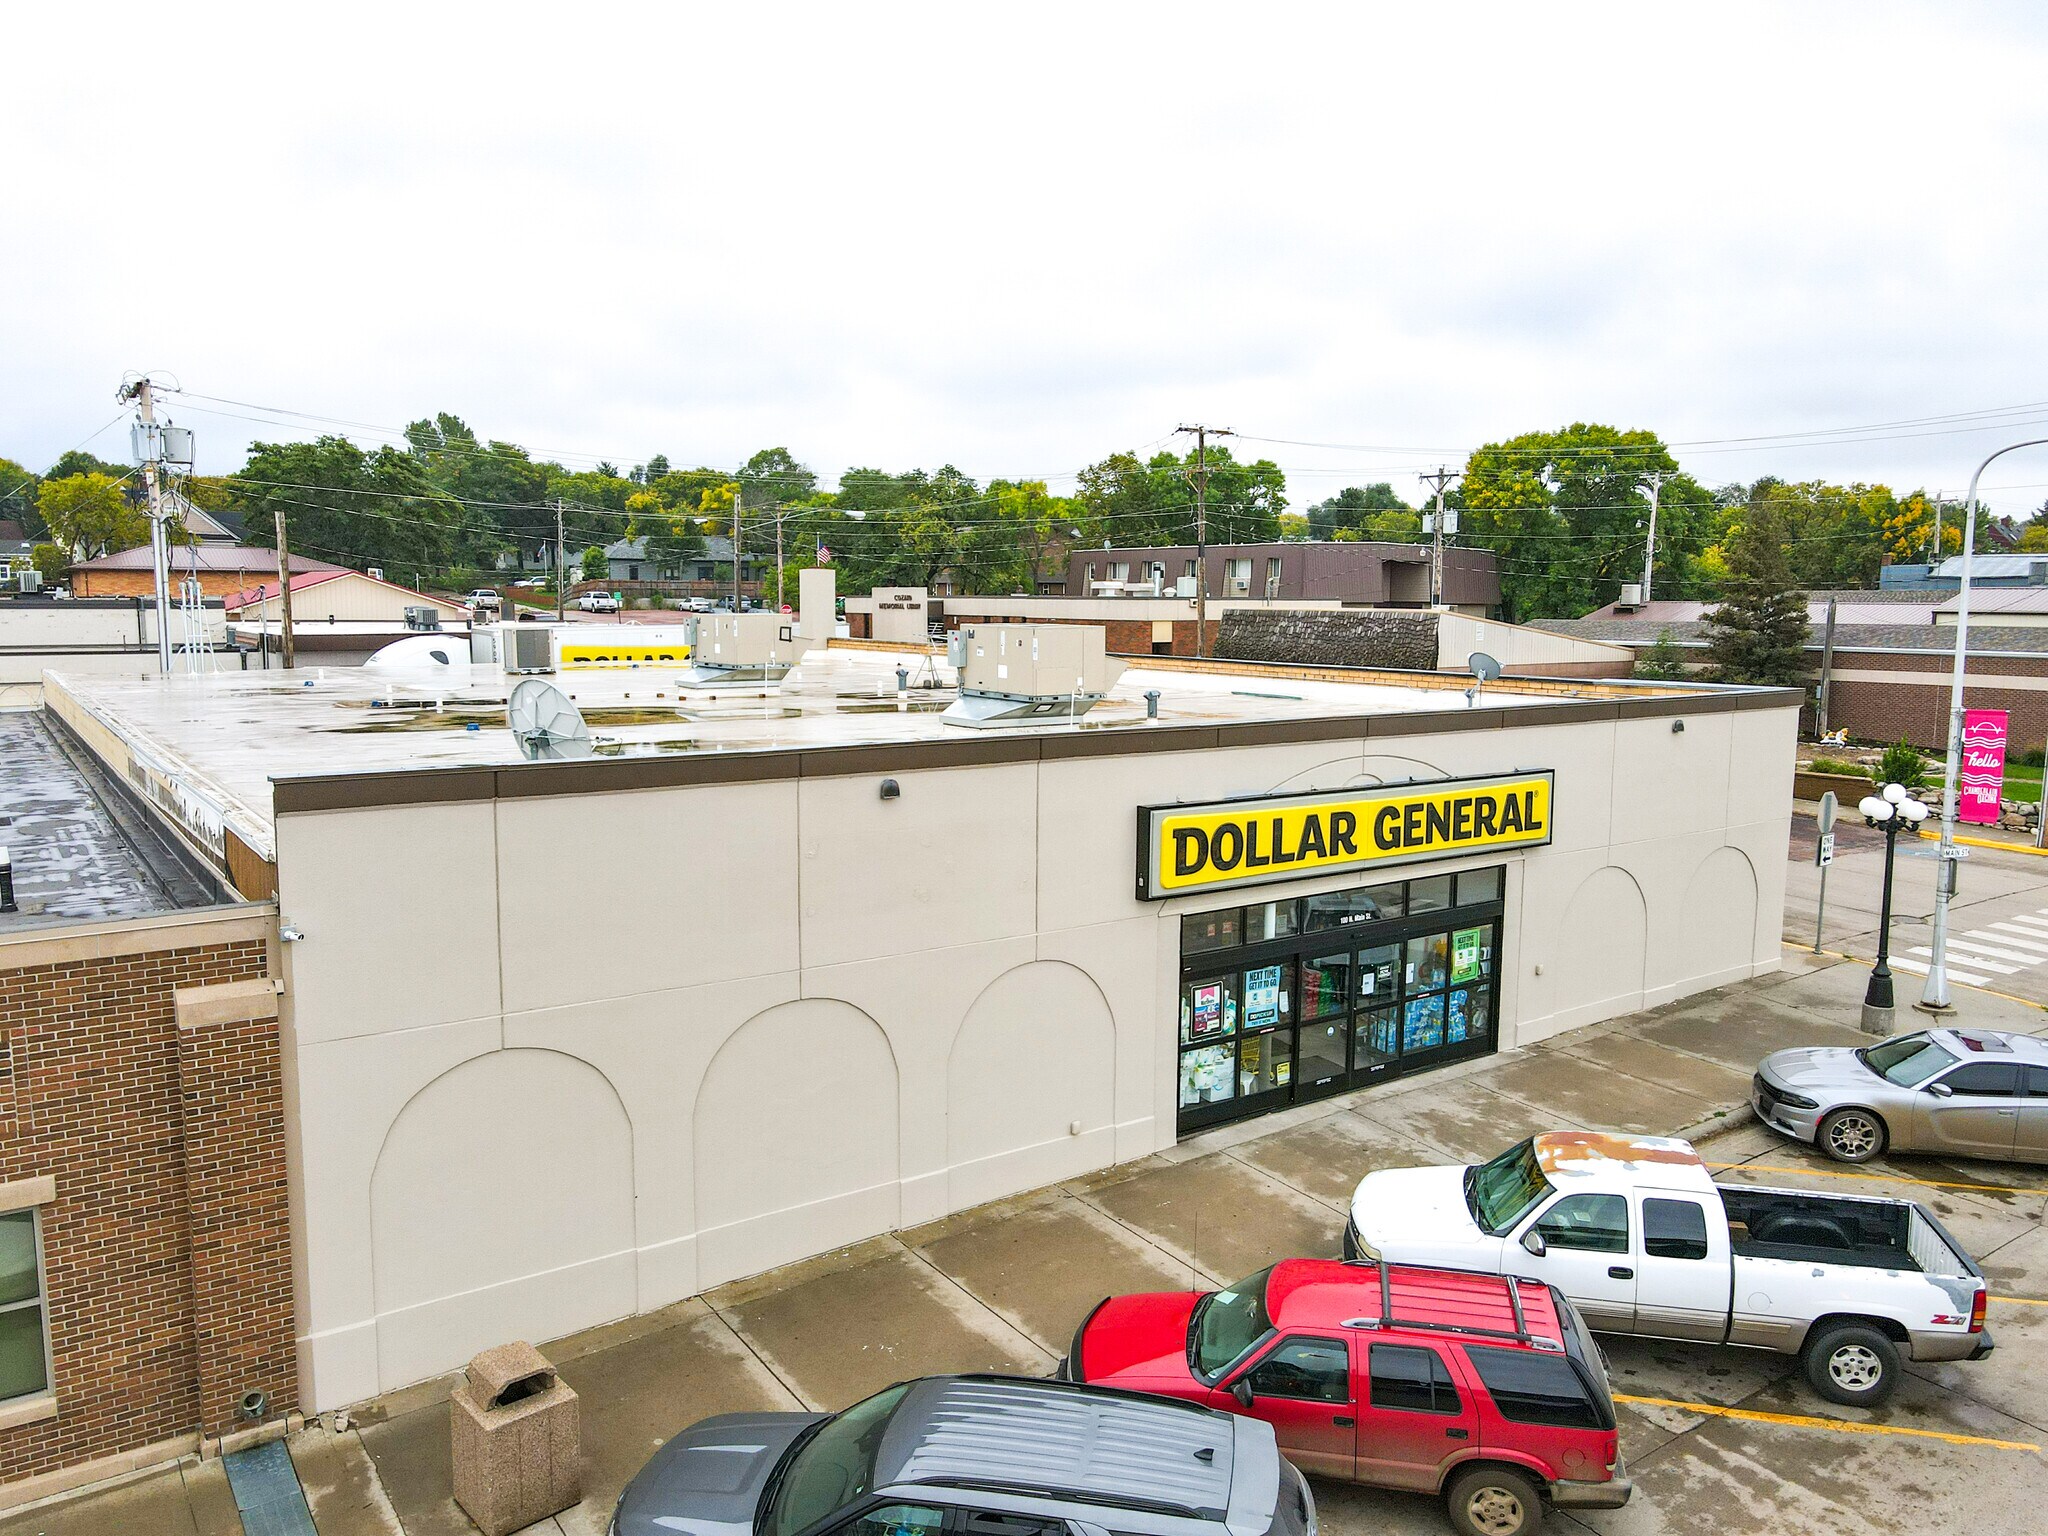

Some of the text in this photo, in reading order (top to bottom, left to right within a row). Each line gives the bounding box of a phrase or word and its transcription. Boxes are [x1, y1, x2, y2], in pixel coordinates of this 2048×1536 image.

[1963, 751, 2002, 768] hello
[1172, 791, 1543, 876] DOLLAR GENERAL
[1823, 836, 1833, 846] ONE
[1249, 969, 1277, 981] NEXT TIME
[1249, 981, 1258, 990] GET
[1258, 980, 1263, 988] IT
[1930, 1314, 1967, 1325] Z71
